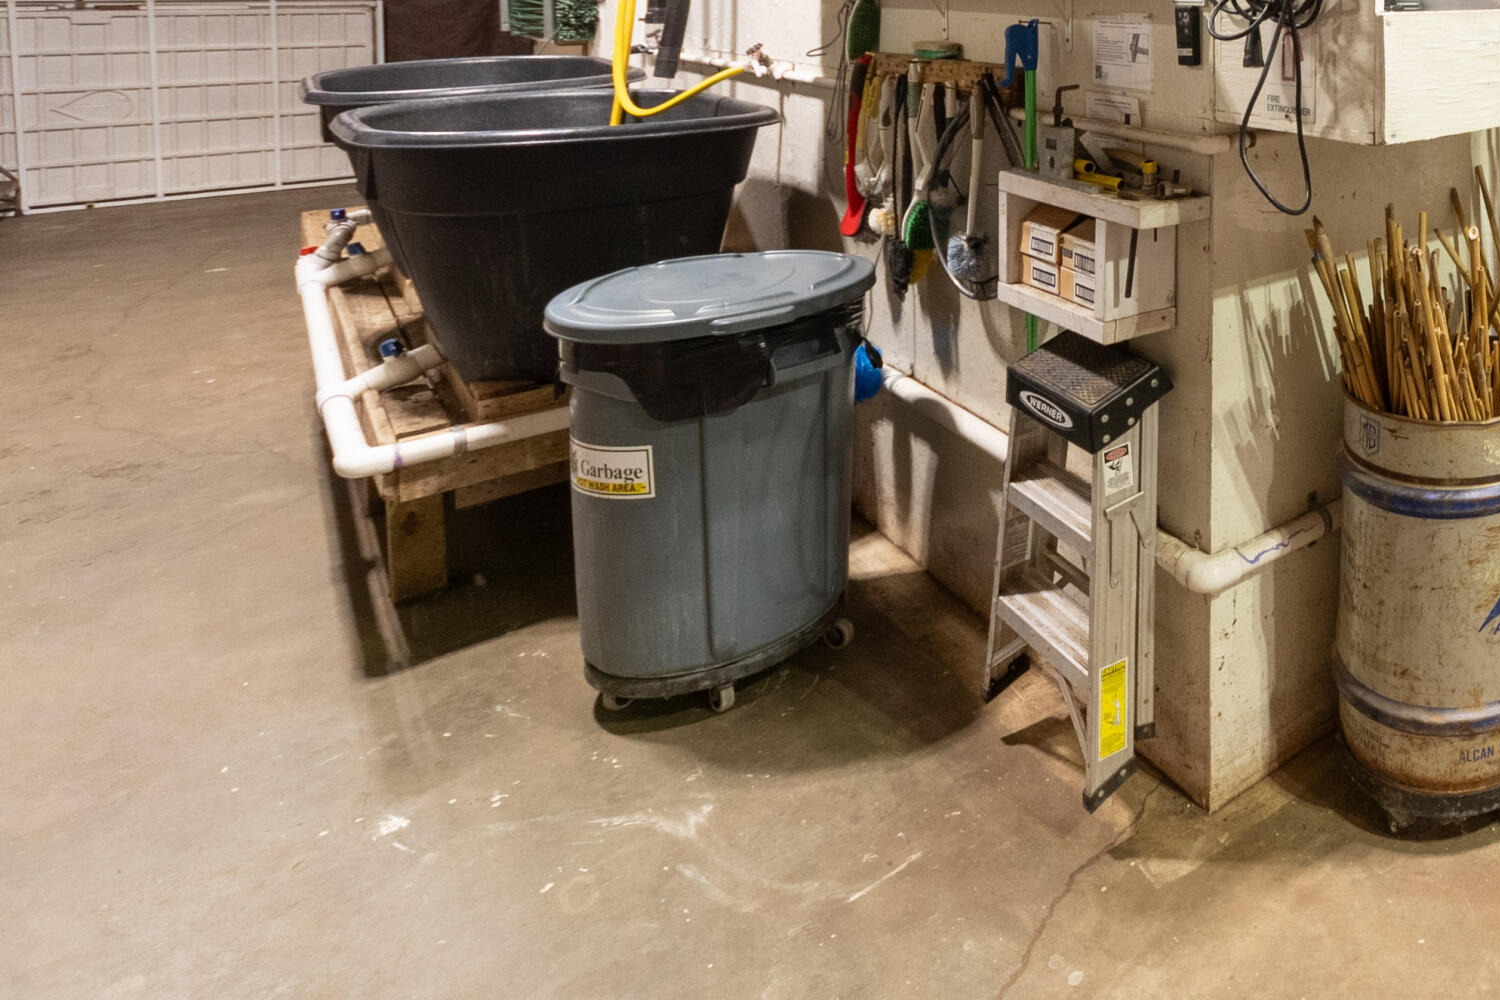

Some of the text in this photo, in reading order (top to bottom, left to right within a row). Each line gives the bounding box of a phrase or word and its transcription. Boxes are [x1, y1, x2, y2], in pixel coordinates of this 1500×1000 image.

[1267, 94, 1280, 104] FIRE
[1028, 395, 1063, 422] WERNER
[581, 459, 643, 483] Garbage
[589, 479, 610, 491] WASH
[612, 483, 635, 492] AREA
[1458, 745, 1495, 763] ALCAN
